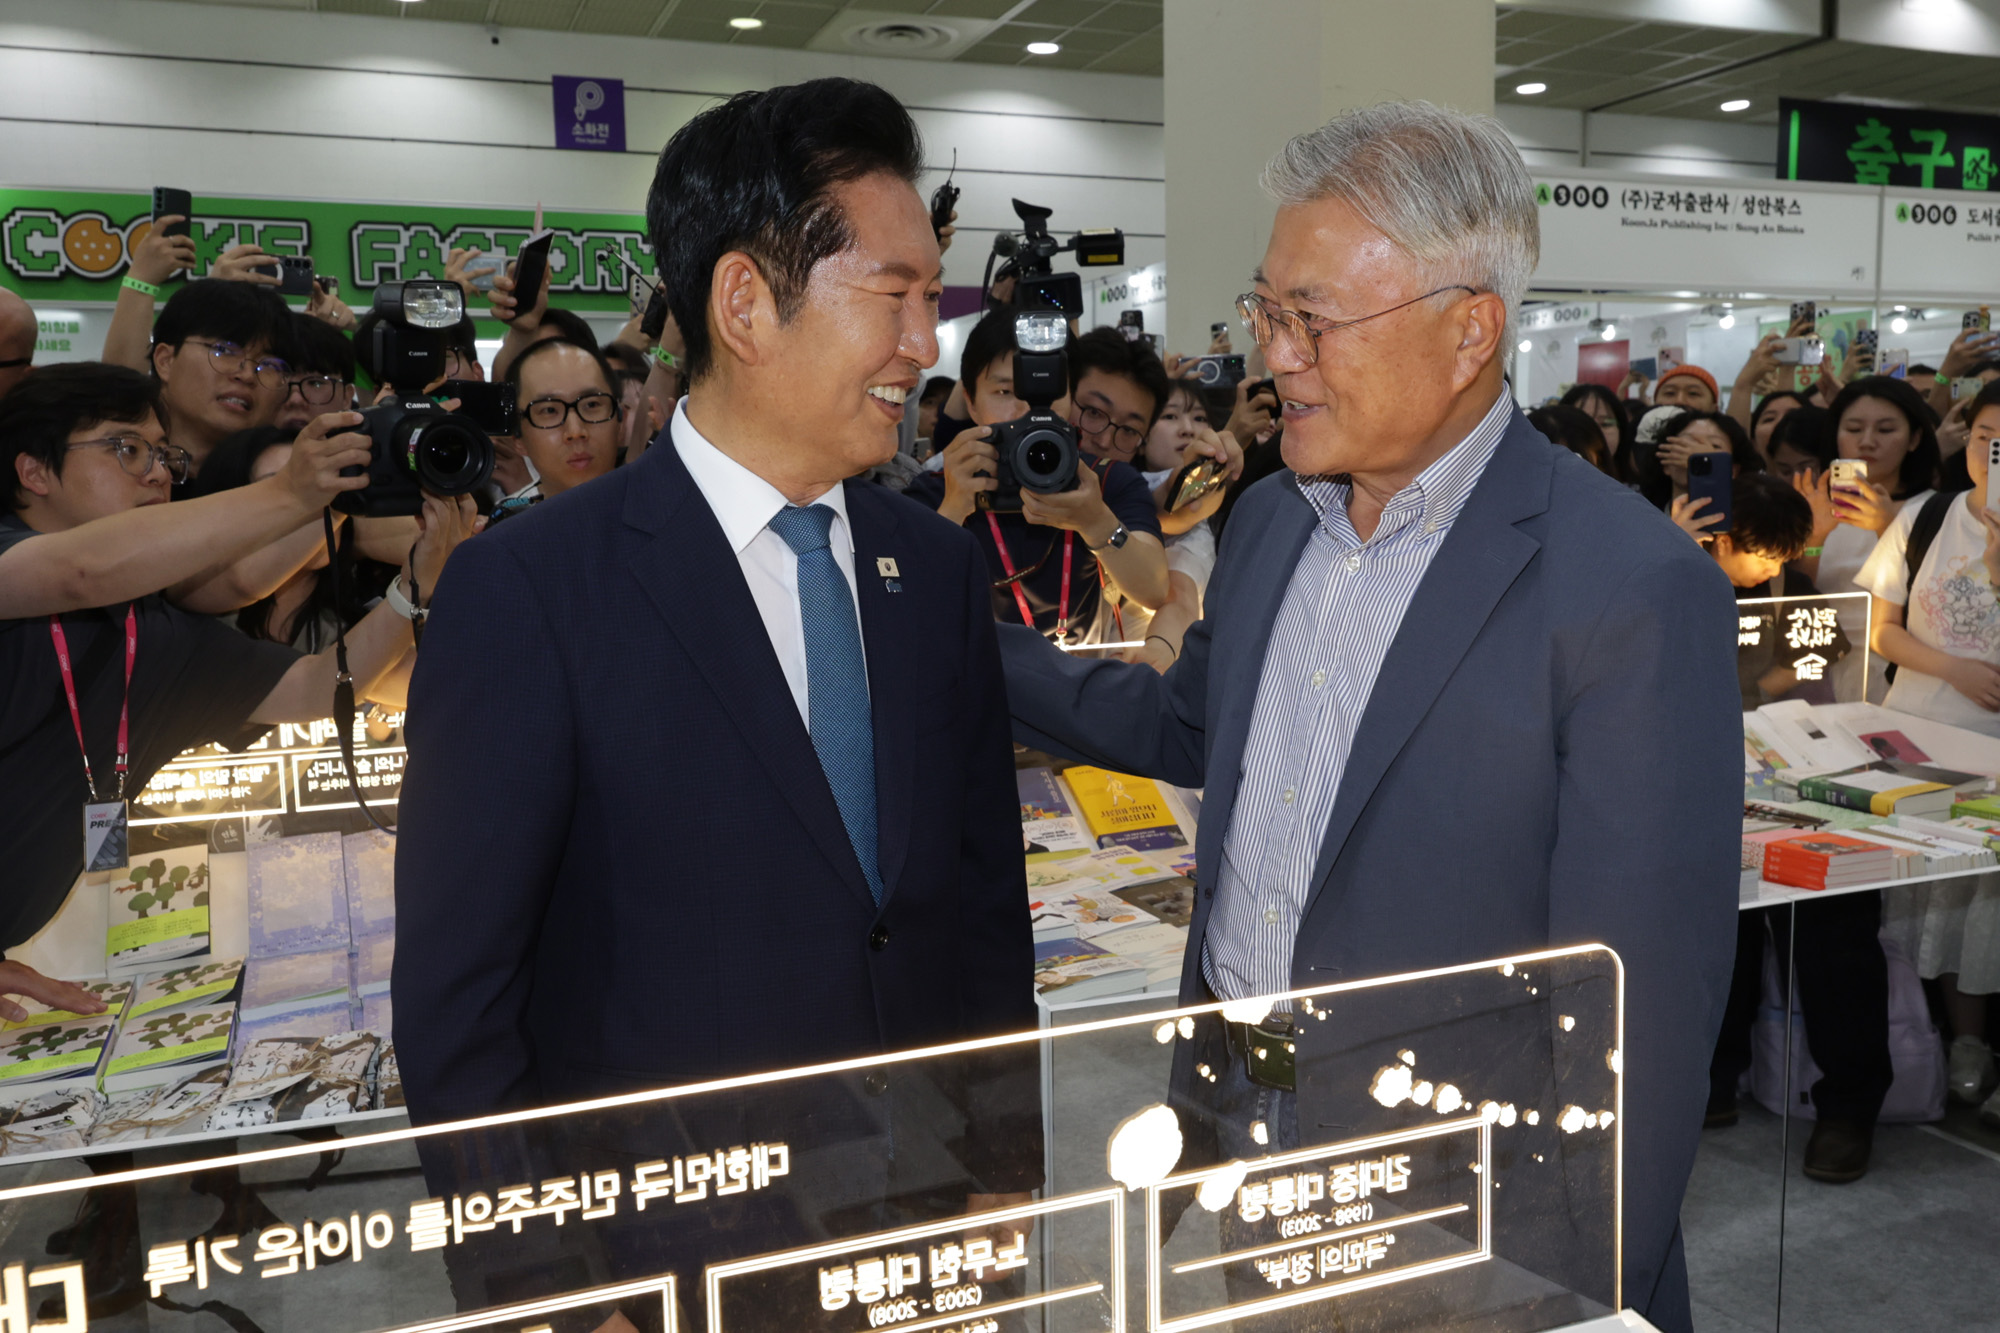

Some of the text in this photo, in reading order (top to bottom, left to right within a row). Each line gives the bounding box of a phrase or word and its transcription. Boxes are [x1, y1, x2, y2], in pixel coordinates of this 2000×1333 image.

[571, 122, 610, 138] 소화전
[1846, 118, 1956, 188] 출구
[1621, 189, 1730, 214] (주)군자출판사
[1741, 195, 1803, 216] 성안북스
[1661, 218, 1712, 232] Publishing
[90, 817, 127, 829] PRESS
